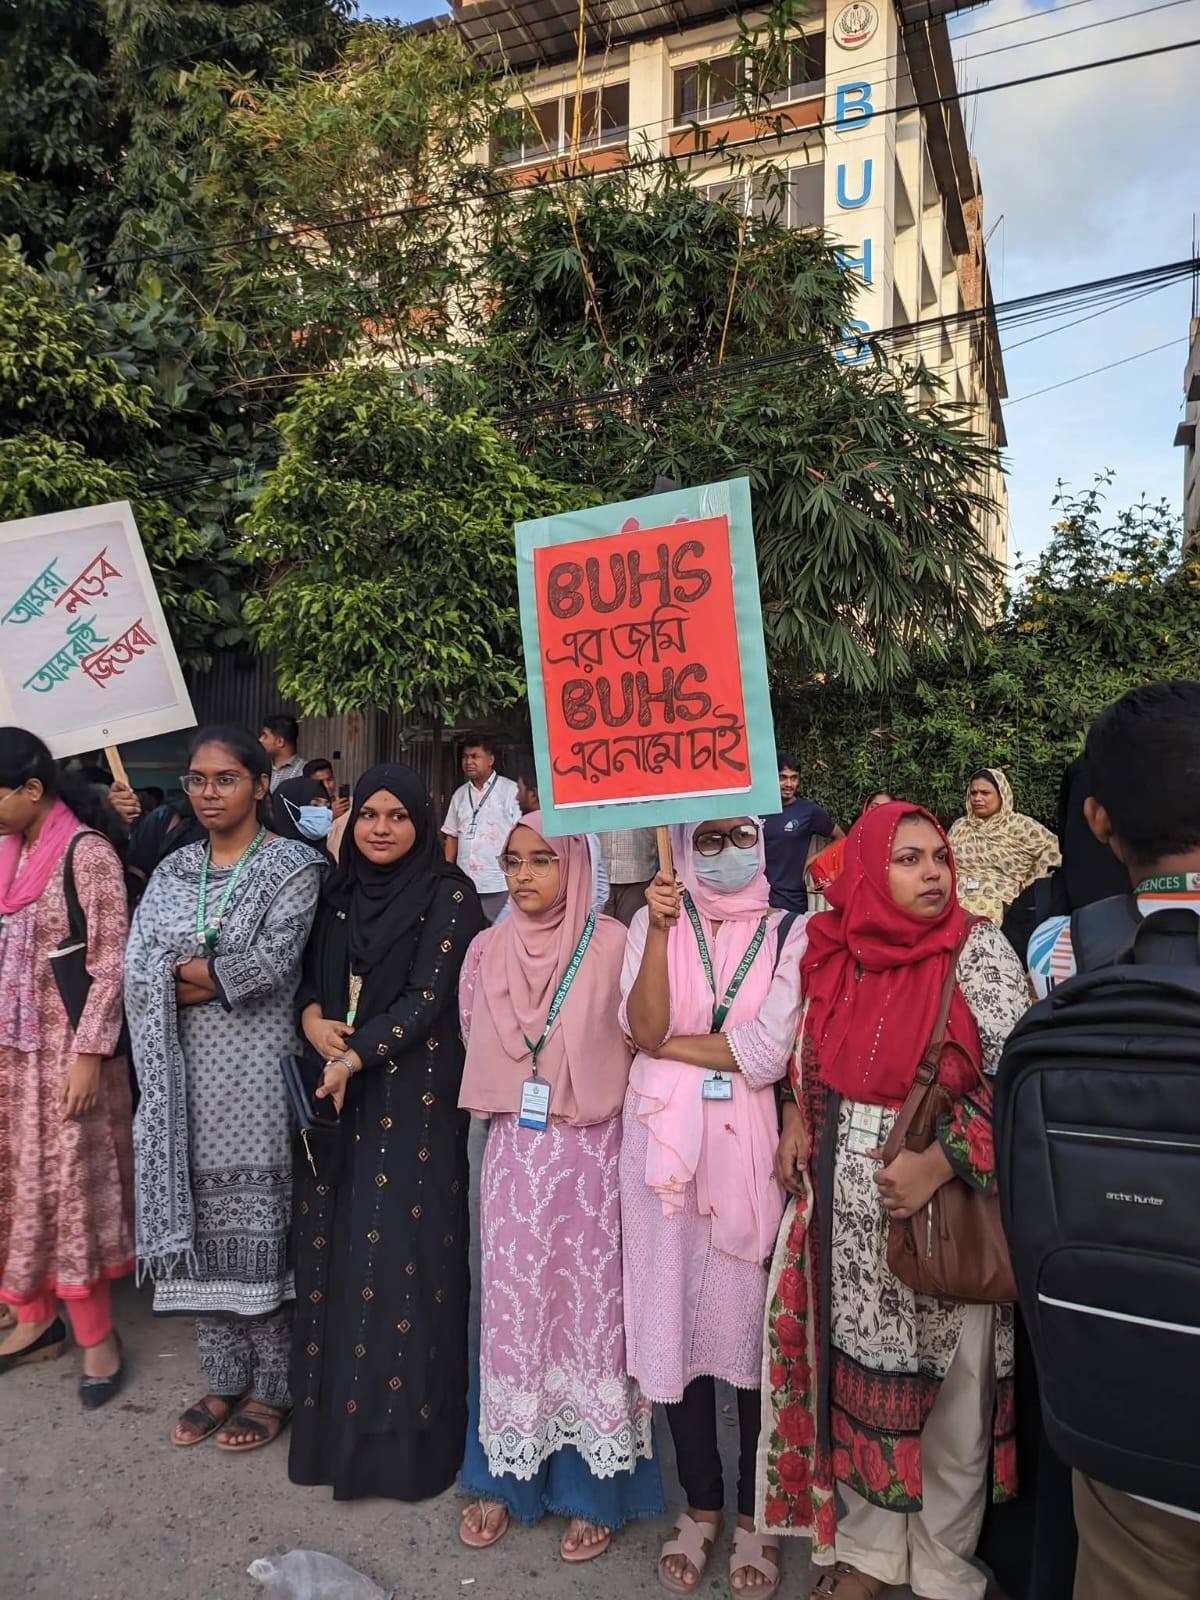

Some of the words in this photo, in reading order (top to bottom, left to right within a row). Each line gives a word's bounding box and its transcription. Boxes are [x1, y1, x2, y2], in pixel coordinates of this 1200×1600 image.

[834, 81, 874, 366] BUHS
[1, 557, 69, 625] আমরা
[547, 540, 712, 619] BUHS
[23, 614, 110, 692] আমরাই
[81, 617, 157, 688] জিতবো
[546, 627, 606, 673] এর
[610, 604, 690, 666] জমি
[561, 664, 711, 729] BUHS
[686, 705, 746, 772] চাই
[560, 965, 576, 989] HEALTH
[571, 956, 580, 966] OF
[743, 940, 759, 963] HEALTH
